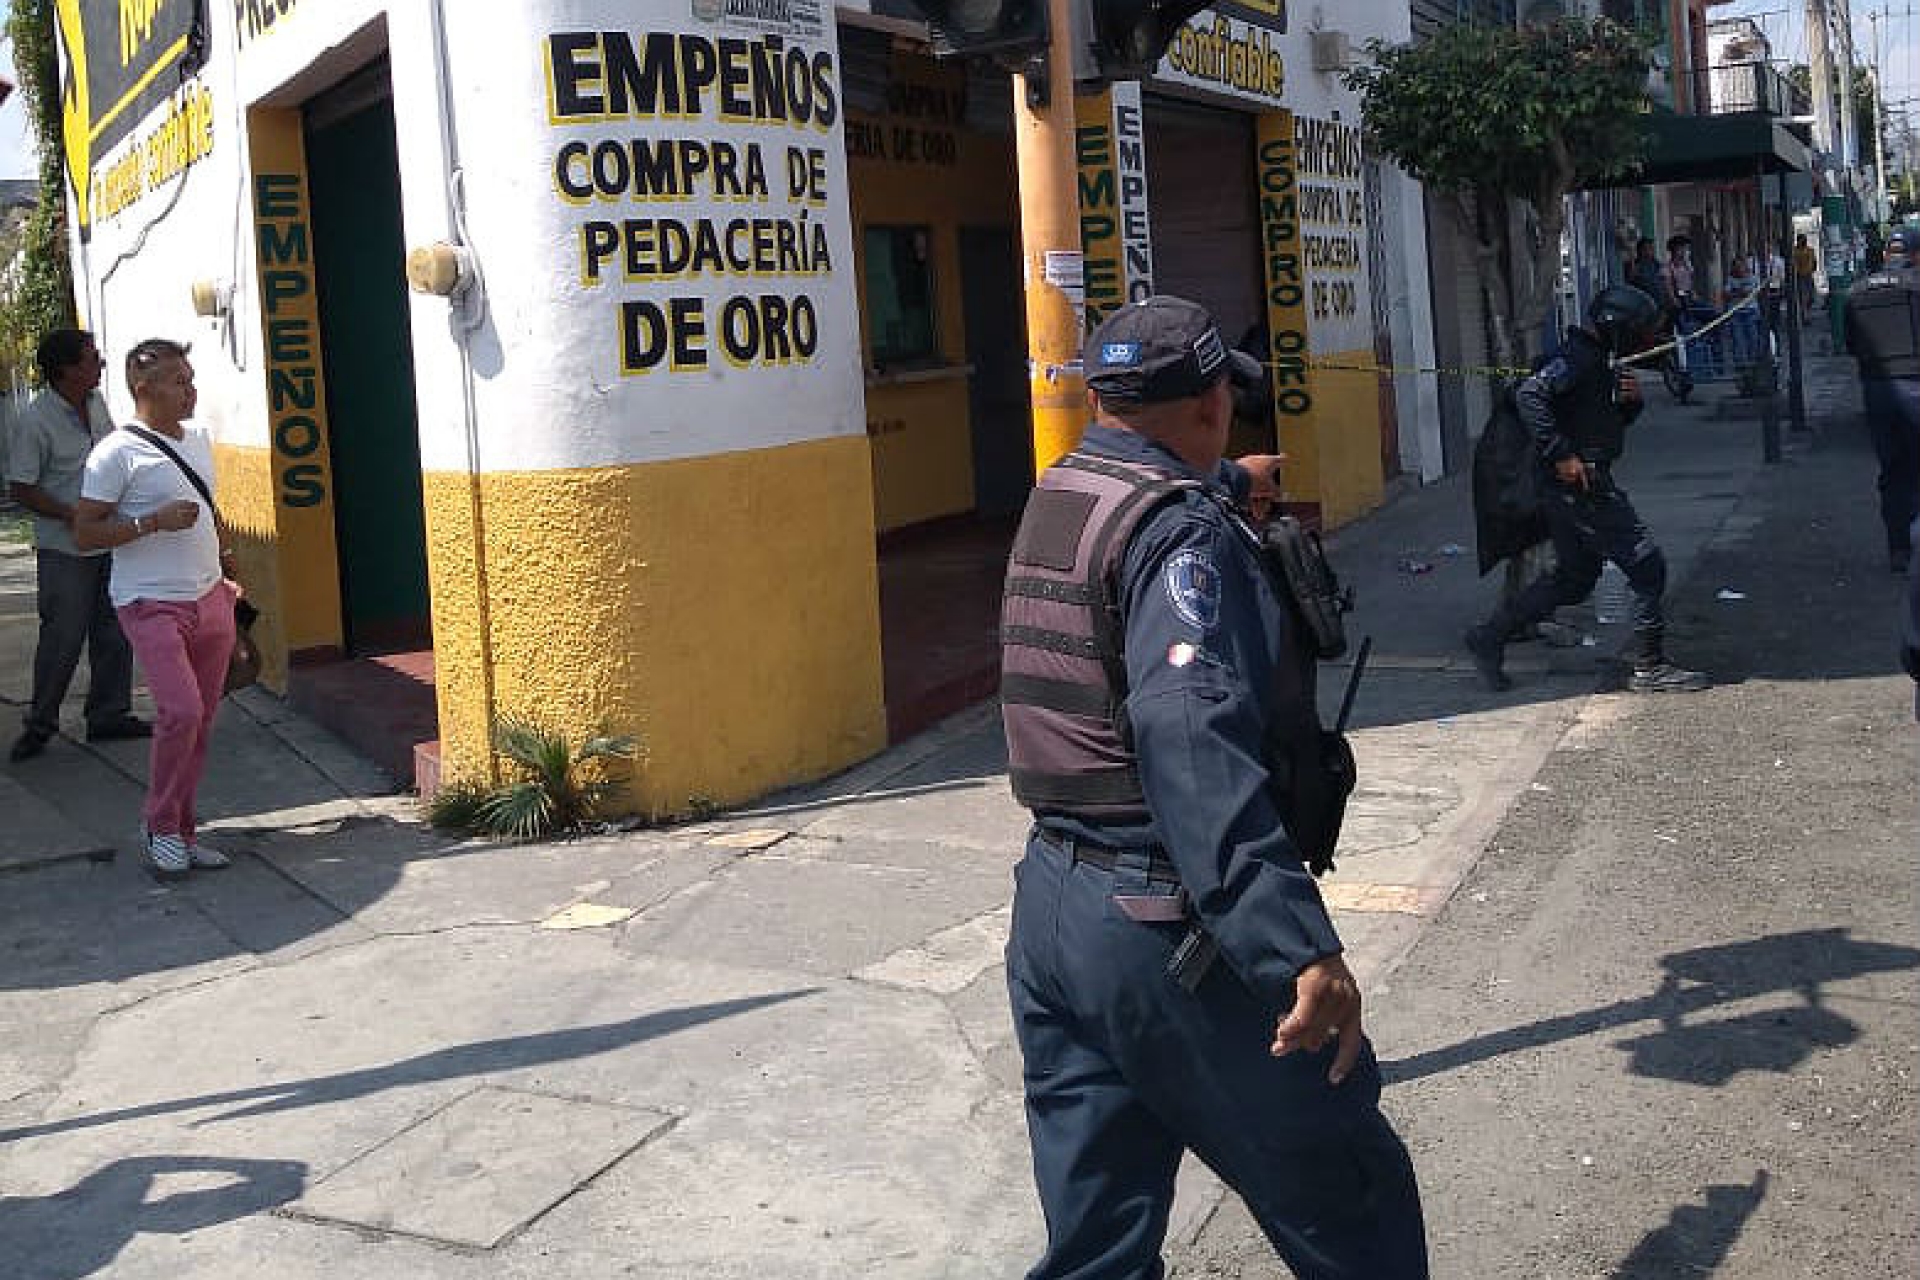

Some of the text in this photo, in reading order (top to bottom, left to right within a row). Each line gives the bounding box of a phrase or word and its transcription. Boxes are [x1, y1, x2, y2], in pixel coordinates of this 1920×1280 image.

[545, 31, 837, 133] EMPEÑOS
[556, 138, 828, 206] COMPRA DE
[580, 209, 832, 287] PEDACERÍA
[1260, 139, 1311, 414] COMPRO ORO
[255, 174, 325, 508] EMPEÑOS
[619, 295, 818, 377] DE ORO
